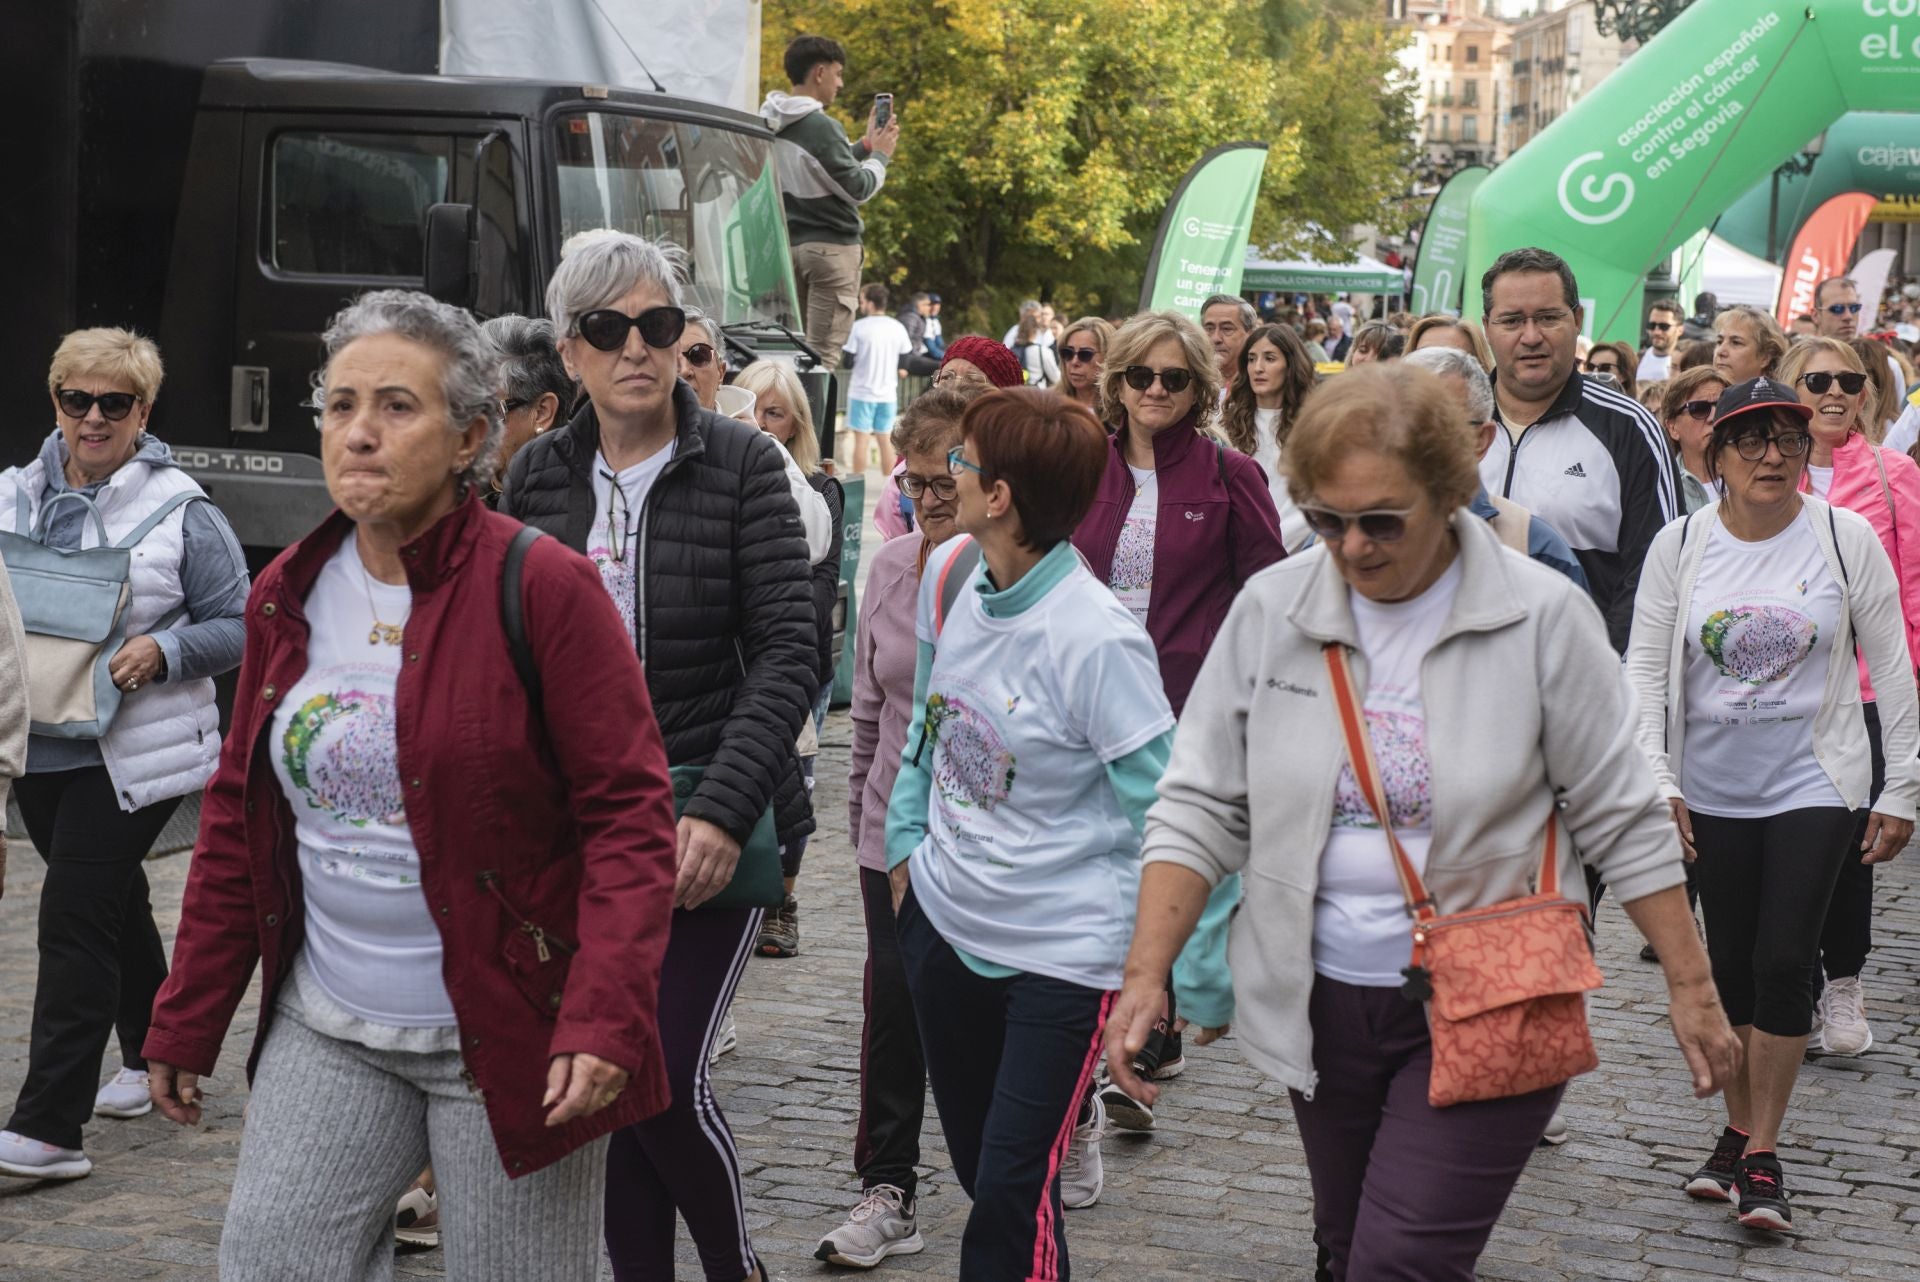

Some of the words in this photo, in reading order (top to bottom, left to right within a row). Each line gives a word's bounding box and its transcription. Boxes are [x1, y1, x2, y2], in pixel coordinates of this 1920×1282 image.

[1862, 0, 1920, 18] co
[1860, 24, 1903, 60] el
[1617, 72, 1705, 147] asociación
[1703, 11, 1780, 77] española
[1631, 115, 1687, 163] contra
[1685, 98, 1705, 120] el
[1702, 54, 1761, 105] cáncer
[1646, 156, 1673, 180] en
[1668, 99, 1744, 160] Segovia
[1176, 279, 1193, 290] un
[1194, 282, 1224, 296] gran
[1564, 470, 1587, 478] adidas
